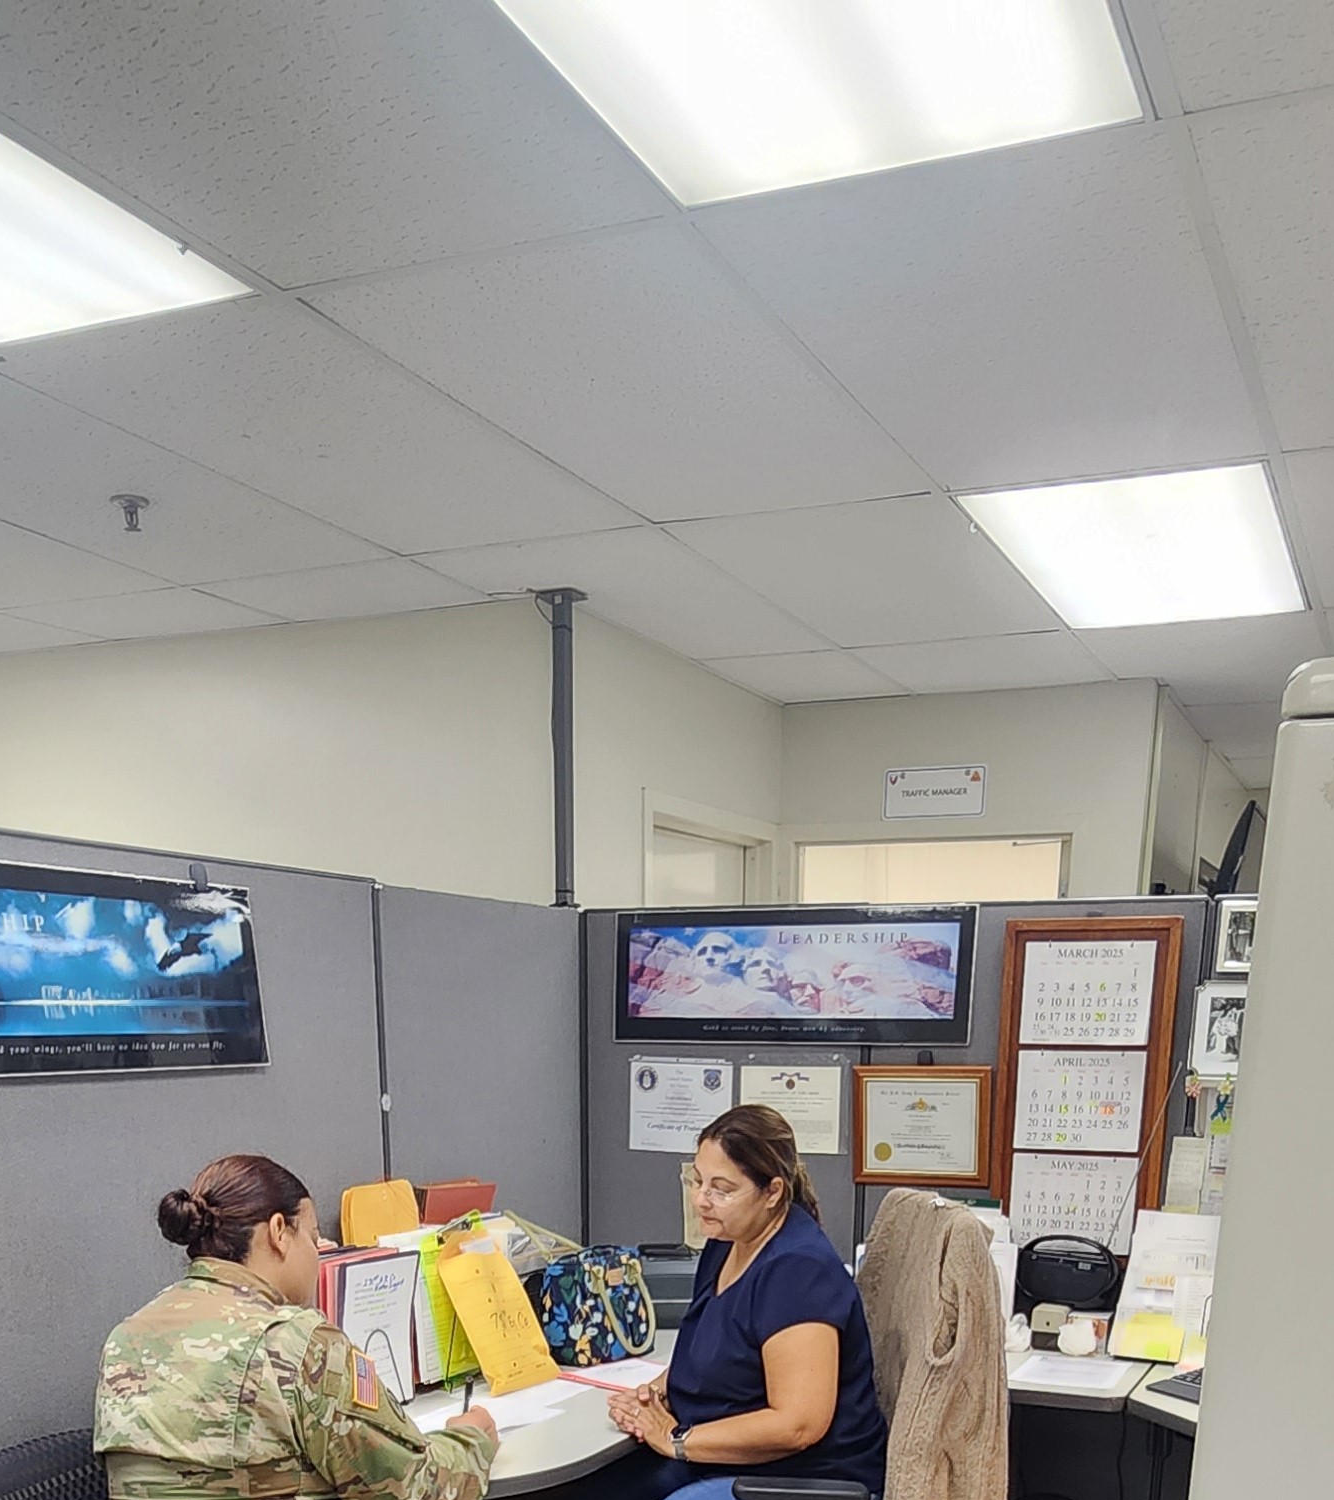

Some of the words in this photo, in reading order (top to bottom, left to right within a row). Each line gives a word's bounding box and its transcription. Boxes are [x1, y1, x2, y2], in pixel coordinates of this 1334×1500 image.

[902, 789, 930, 797] TRAFFIC
[932, 787, 967, 796] MANAGER
[777, 930, 909, 946] LEADERSHIP
[1058, 949, 1098, 958] MARCH
[1101, 949, 1124, 958] 2025
[1039, 983, 1045, 992] 2
[1054, 983, 1060, 992] 3
[1068, 983, 1075, 992] 4
[1084, 983, 1090, 992] 5
[1099, 983, 1106, 992] 6
[1115, 983, 1121, 993] 7
[1131, 983, 1137, 992] 8
[1037, 998, 1044, 1006] 9
[1051, 998, 1062, 1006] 10
[1067, 998, 1075, 1006] 11
[1081, 998, 1092, 1007] 12
[1097, 998, 1107, 1007] 13
[1112, 998, 1122, 1007] 14
[1127, 998, 1138, 1007] 15
[1035, 1012, 1045, 1021] 16
[1050, 1012, 1060, 1021] 17
[1065, 1013, 1076, 1021] 18
[1081, 1013, 1091, 1021] 19
[1095, 1013, 1106, 1021] 20
[1110, 1013, 1120, 1022] 21
[1125, 1013, 1137, 1022] 22
[1063, 1028, 1074, 1036] 25
[1078, 1028, 1090, 1036] 26
[1093, 1028, 1105, 1036] 27
[1108, 1028, 1120, 1036] 28
[1123, 1028, 1135, 1037] 29
[1054, 1058, 1085, 1066] APRIL
[1088, 1058, 1110, 1067] 2025
[1078, 1076, 1083, 1085] 2
[1093, 1076, 1098, 1085] 3
[1108, 1076, 1113, 1085] 4
[1123, 1077, 1129, 1086] 5
[1031, 1090, 1037, 1098] 6
[1047, 1090, 1052, 1098] 7
[1061, 1090, 1067, 1099] 8
[1077, 1091, 1082, 1099] 9
[1090, 1091, 1100, 1100] 10
[1105, 1092, 1114, 1100] 11
[1120, 1092, 1131, 1100] 12
[1029, 1104, 1039, 1113] 13
[1044, 1104, 1054, 1113] 14
[1059, 1104, 1069, 1113] 15
[1073, 1105, 1083, 1114] 16
[1089, 1106, 1099, 1114] 17
[1103, 1106, 1114, 1114] 18
[1119, 1106, 1130, 1115] 19
[1027, 1118, 1038, 1127] 20
[1042, 1119, 1052, 1127] 21
[1057, 1119, 1067, 1128] 22
[1071, 1119, 1083, 1128] 23
[1087, 1120, 1097, 1128] 24
[1101, 1120, 1113, 1129] 25
[1117, 1120, 1129, 1129] 26
[1026, 1132, 1037, 1141] 27
[1041, 1132, 1052, 1141] 28
[1056, 1133, 1067, 1142] 29
[1070, 1134, 1081, 1142] 30
[1051, 1161, 1075, 1170] MAY
[1077, 1162, 1099, 1171] 2025
[1101, 1181, 1105, 1190] 2
[1115, 1181, 1121, 1190] 3
[1040, 1192, 1045, 1200] 5
[1055, 1193, 1060, 1201] 6
[1070, 1194, 1075, 1202] 7
[1084, 1194, 1089, 1202] 8
[1099, 1195, 1104, 1203] 9
[1112, 1196, 1123, 1204] 10
[1023, 1205, 1031, 1213] 11
[1037, 1206, 1047, 1214] 12
[1052, 1206, 1062, 1214] 13
[1065, 1207, 1076, 1215] 14
[1081, 1208, 1091, 1216] 15
[1096, 1209, 1106, 1217] 16
[1111, 1209, 1121, 1218] 17
[1021, 1218, 1031, 1226] 18
[1036, 1219, 1046, 1227] 19
[1050, 1220, 1061, 1228] 20
[1065, 1221, 1075, 1229] 21
[1079, 1222, 1090, 1230] 22
[1094, 1223, 1105, 1231] 23
[1020, 1232, 1031, 1240] 25
